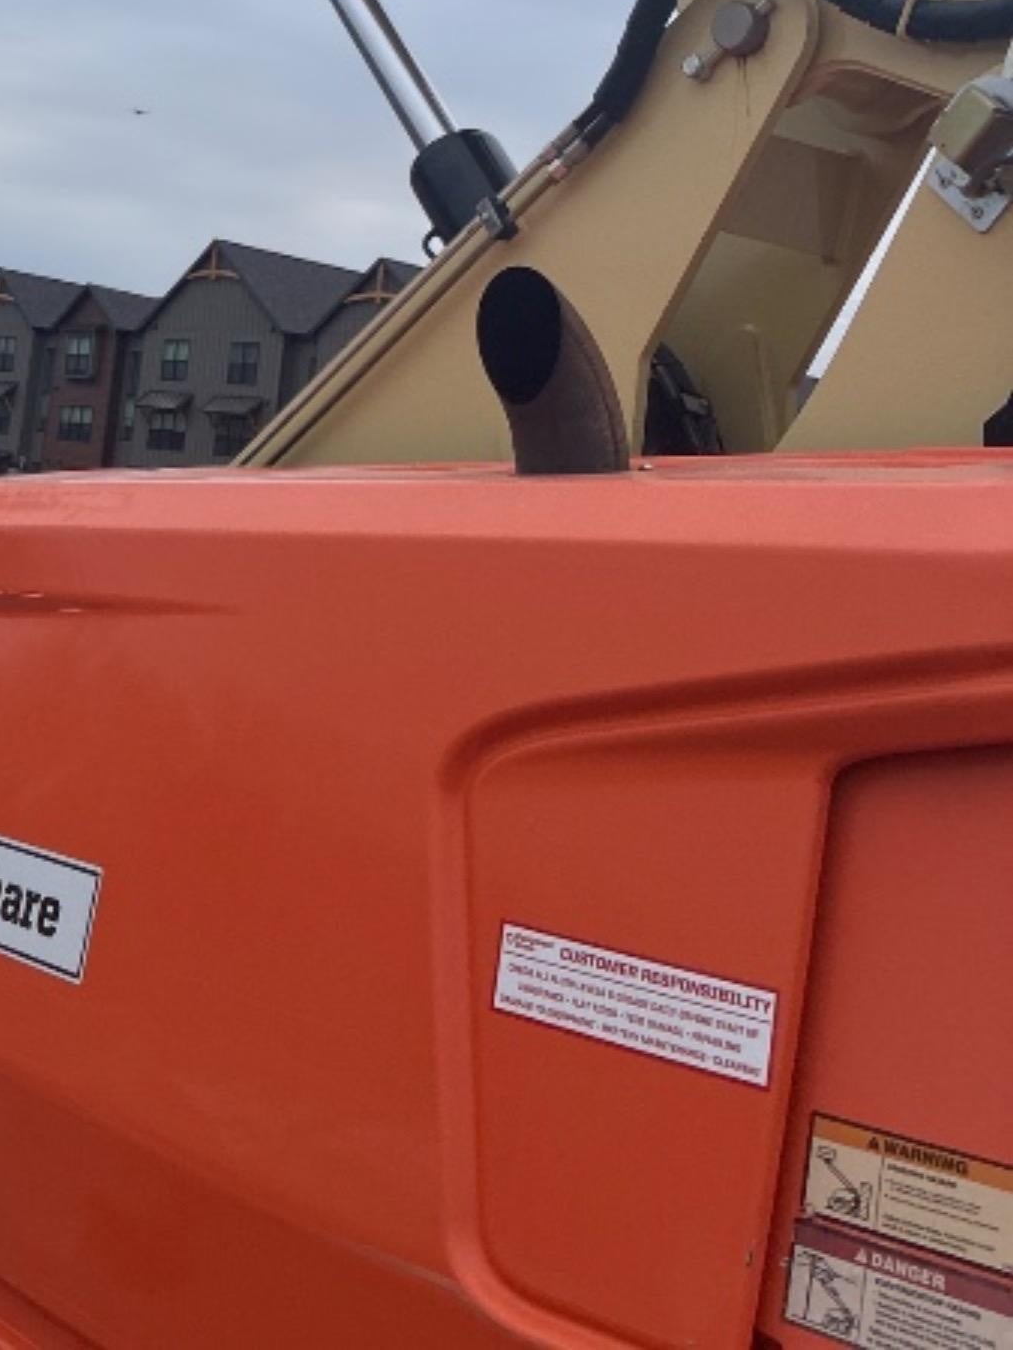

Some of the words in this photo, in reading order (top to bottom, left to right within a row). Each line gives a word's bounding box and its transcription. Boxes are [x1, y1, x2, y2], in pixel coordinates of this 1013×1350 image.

[559, 946, 639, 979] CUSTOMER
[641, 967, 772, 1015] RESPONSIBILITY
[883, 1138, 970, 1176] WARNING
[871, 1252, 947, 1291] DANGER
